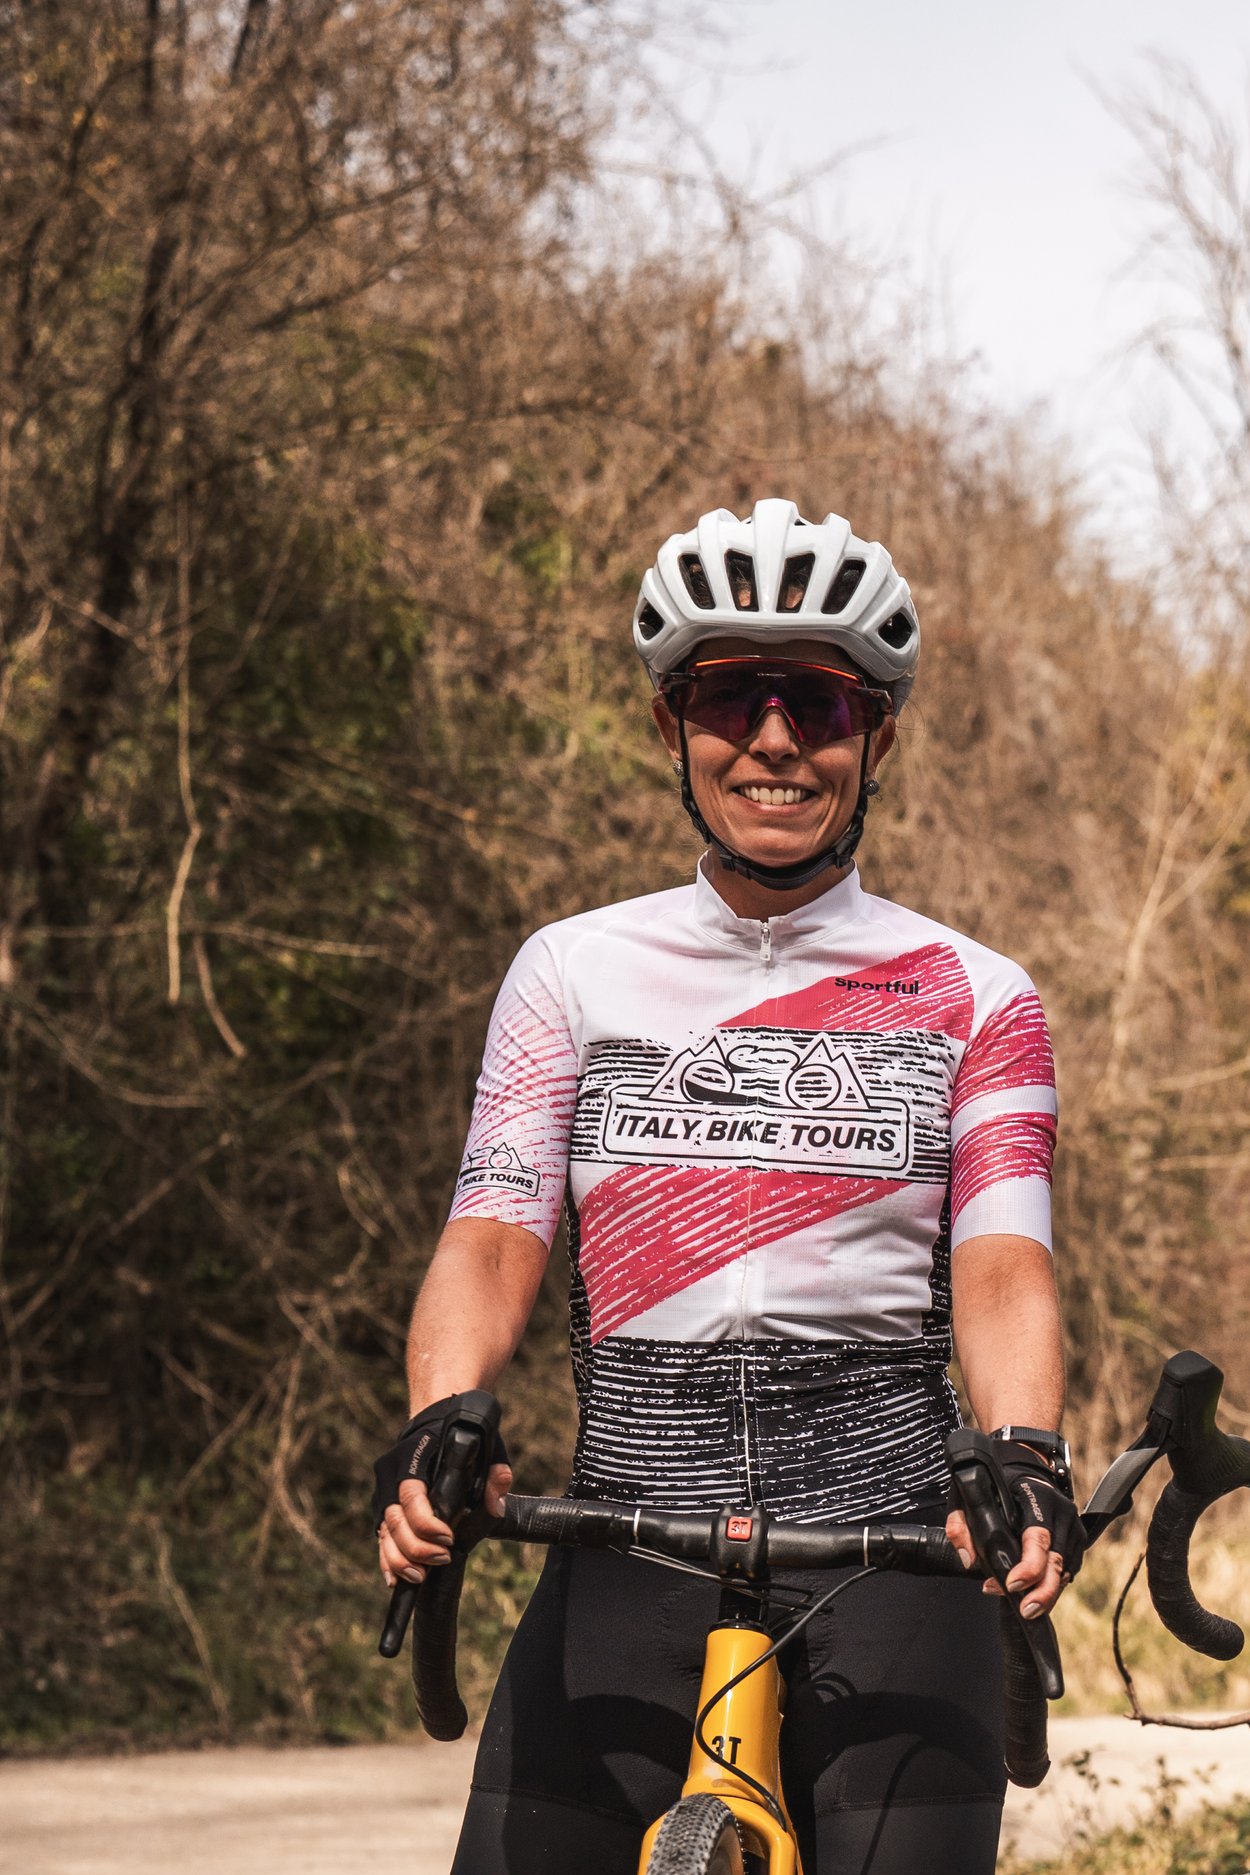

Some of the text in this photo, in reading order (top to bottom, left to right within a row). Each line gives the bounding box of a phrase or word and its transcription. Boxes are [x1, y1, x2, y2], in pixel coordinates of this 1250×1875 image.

[834, 977, 919, 995] sportful
[615, 1114, 897, 1152] ITALY BIKE TOURS
[461, 1173, 487, 1188] BIKE
[490, 1173, 535, 1190] TOURS
[409, 1434, 432, 1476] BONTRAGER
[1020, 1482, 1045, 1523] BONTRAGER
[731, 1520, 749, 1534] 3T
[711, 1735, 742, 1765] 3T
